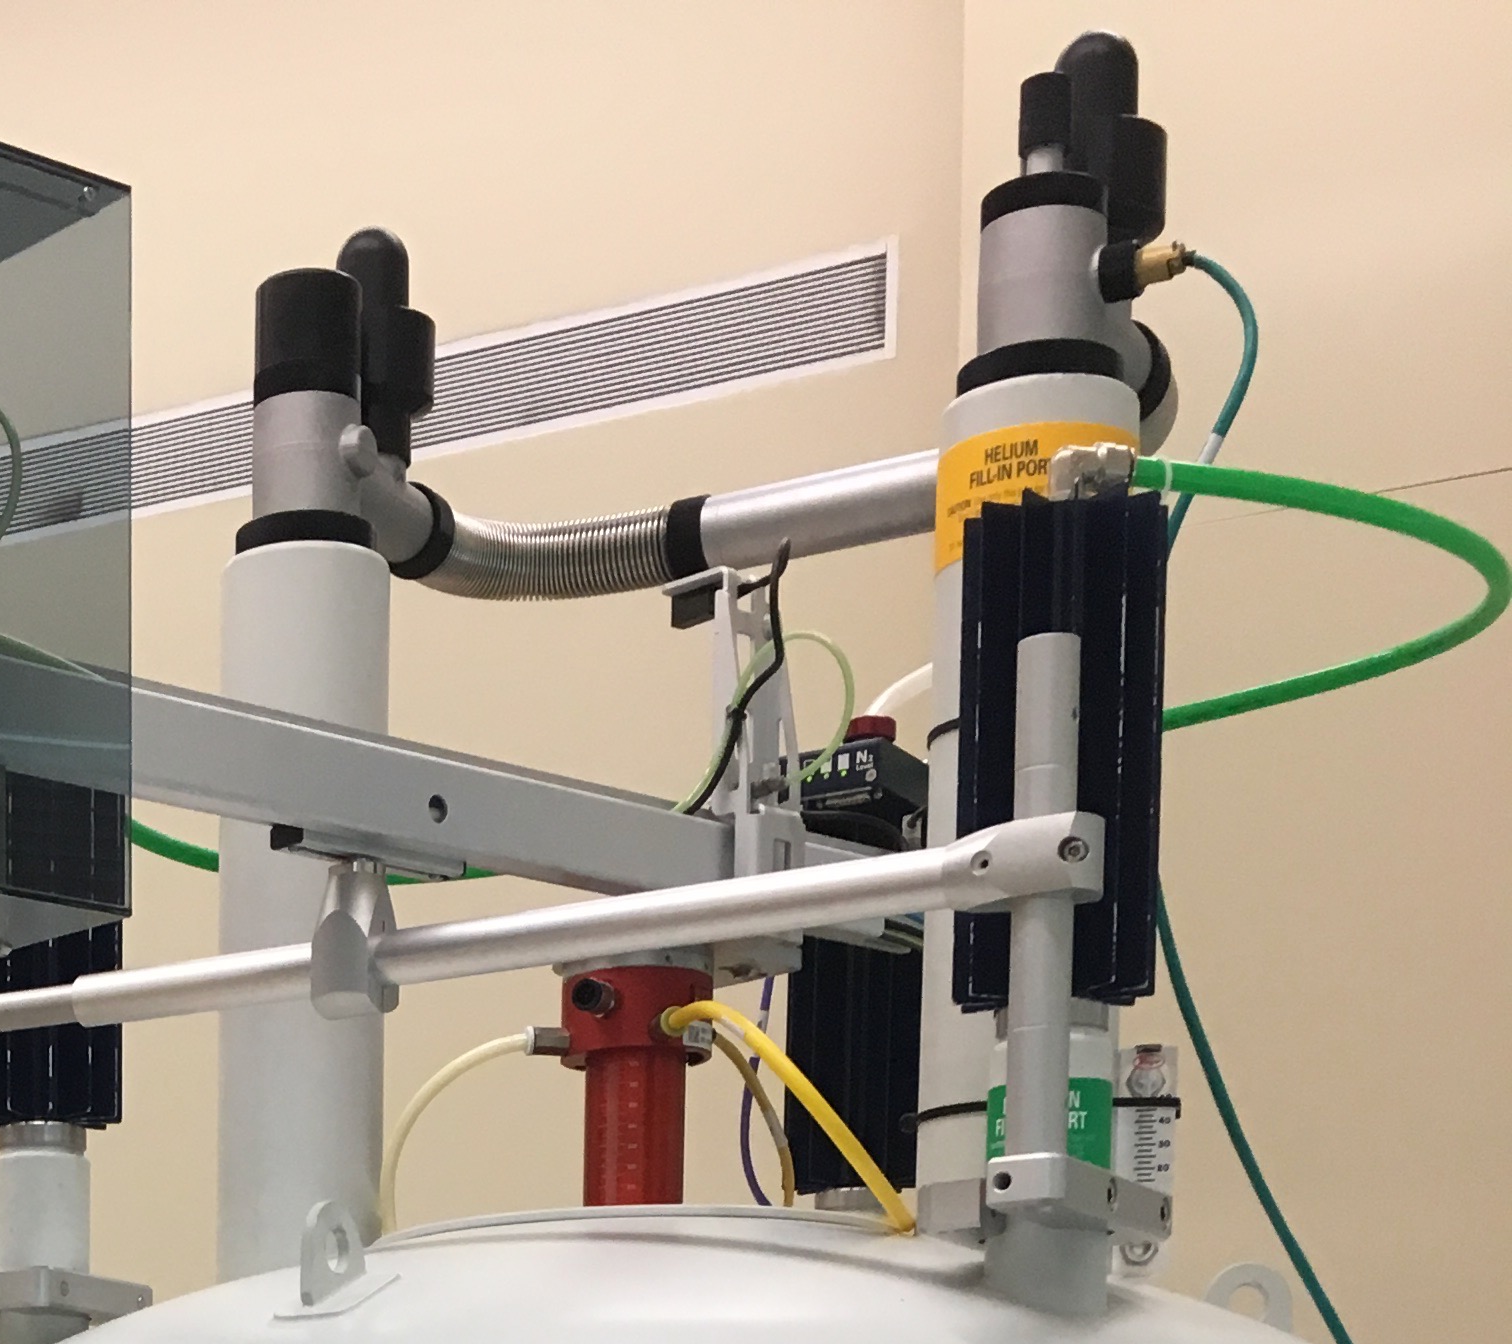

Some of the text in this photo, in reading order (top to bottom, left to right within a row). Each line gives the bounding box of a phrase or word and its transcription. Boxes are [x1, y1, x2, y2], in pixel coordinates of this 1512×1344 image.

[984, 439, 1039, 466] HELIUM
[969, 458, 1051, 490] FILL-IN POR
